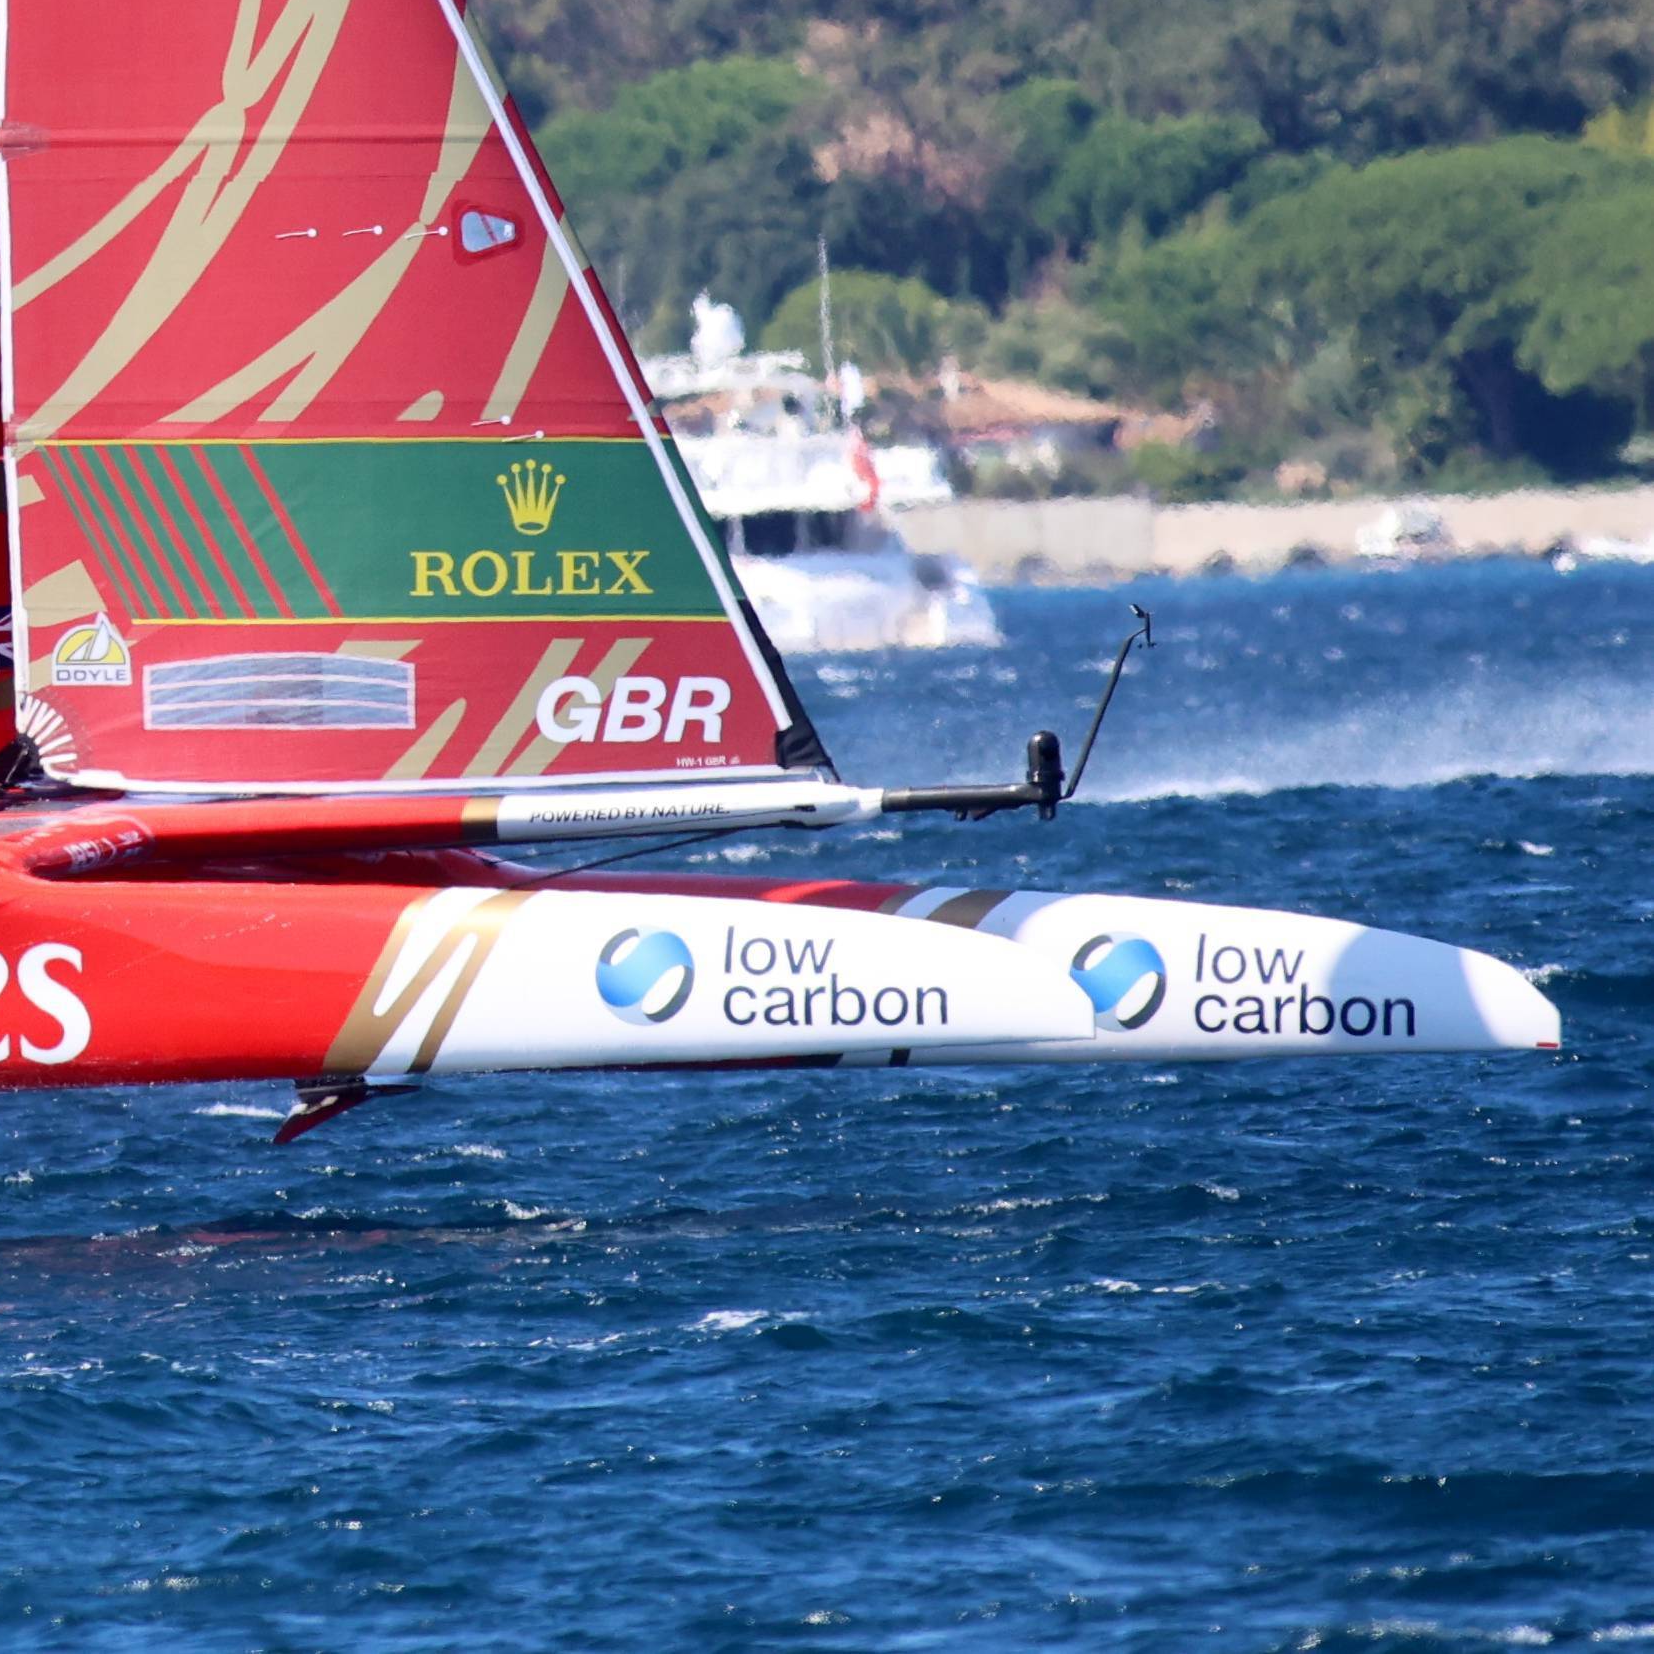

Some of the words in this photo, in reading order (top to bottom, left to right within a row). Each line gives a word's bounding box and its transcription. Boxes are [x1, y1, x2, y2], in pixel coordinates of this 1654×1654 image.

[409, 550, 655, 598] ROLEX
[56, 669, 128, 682] DOYLE
[535, 675, 732, 744] GBR
[529, 806, 621, 824] POWERED
[625, 805, 647, 820] BY
[651, 802, 731, 819] NATURE.
[724, 926, 836, 975] low
[1194, 934, 1305, 984] low
[723, 974, 949, 1027] carbon
[1194, 983, 1417, 1038] carbon
